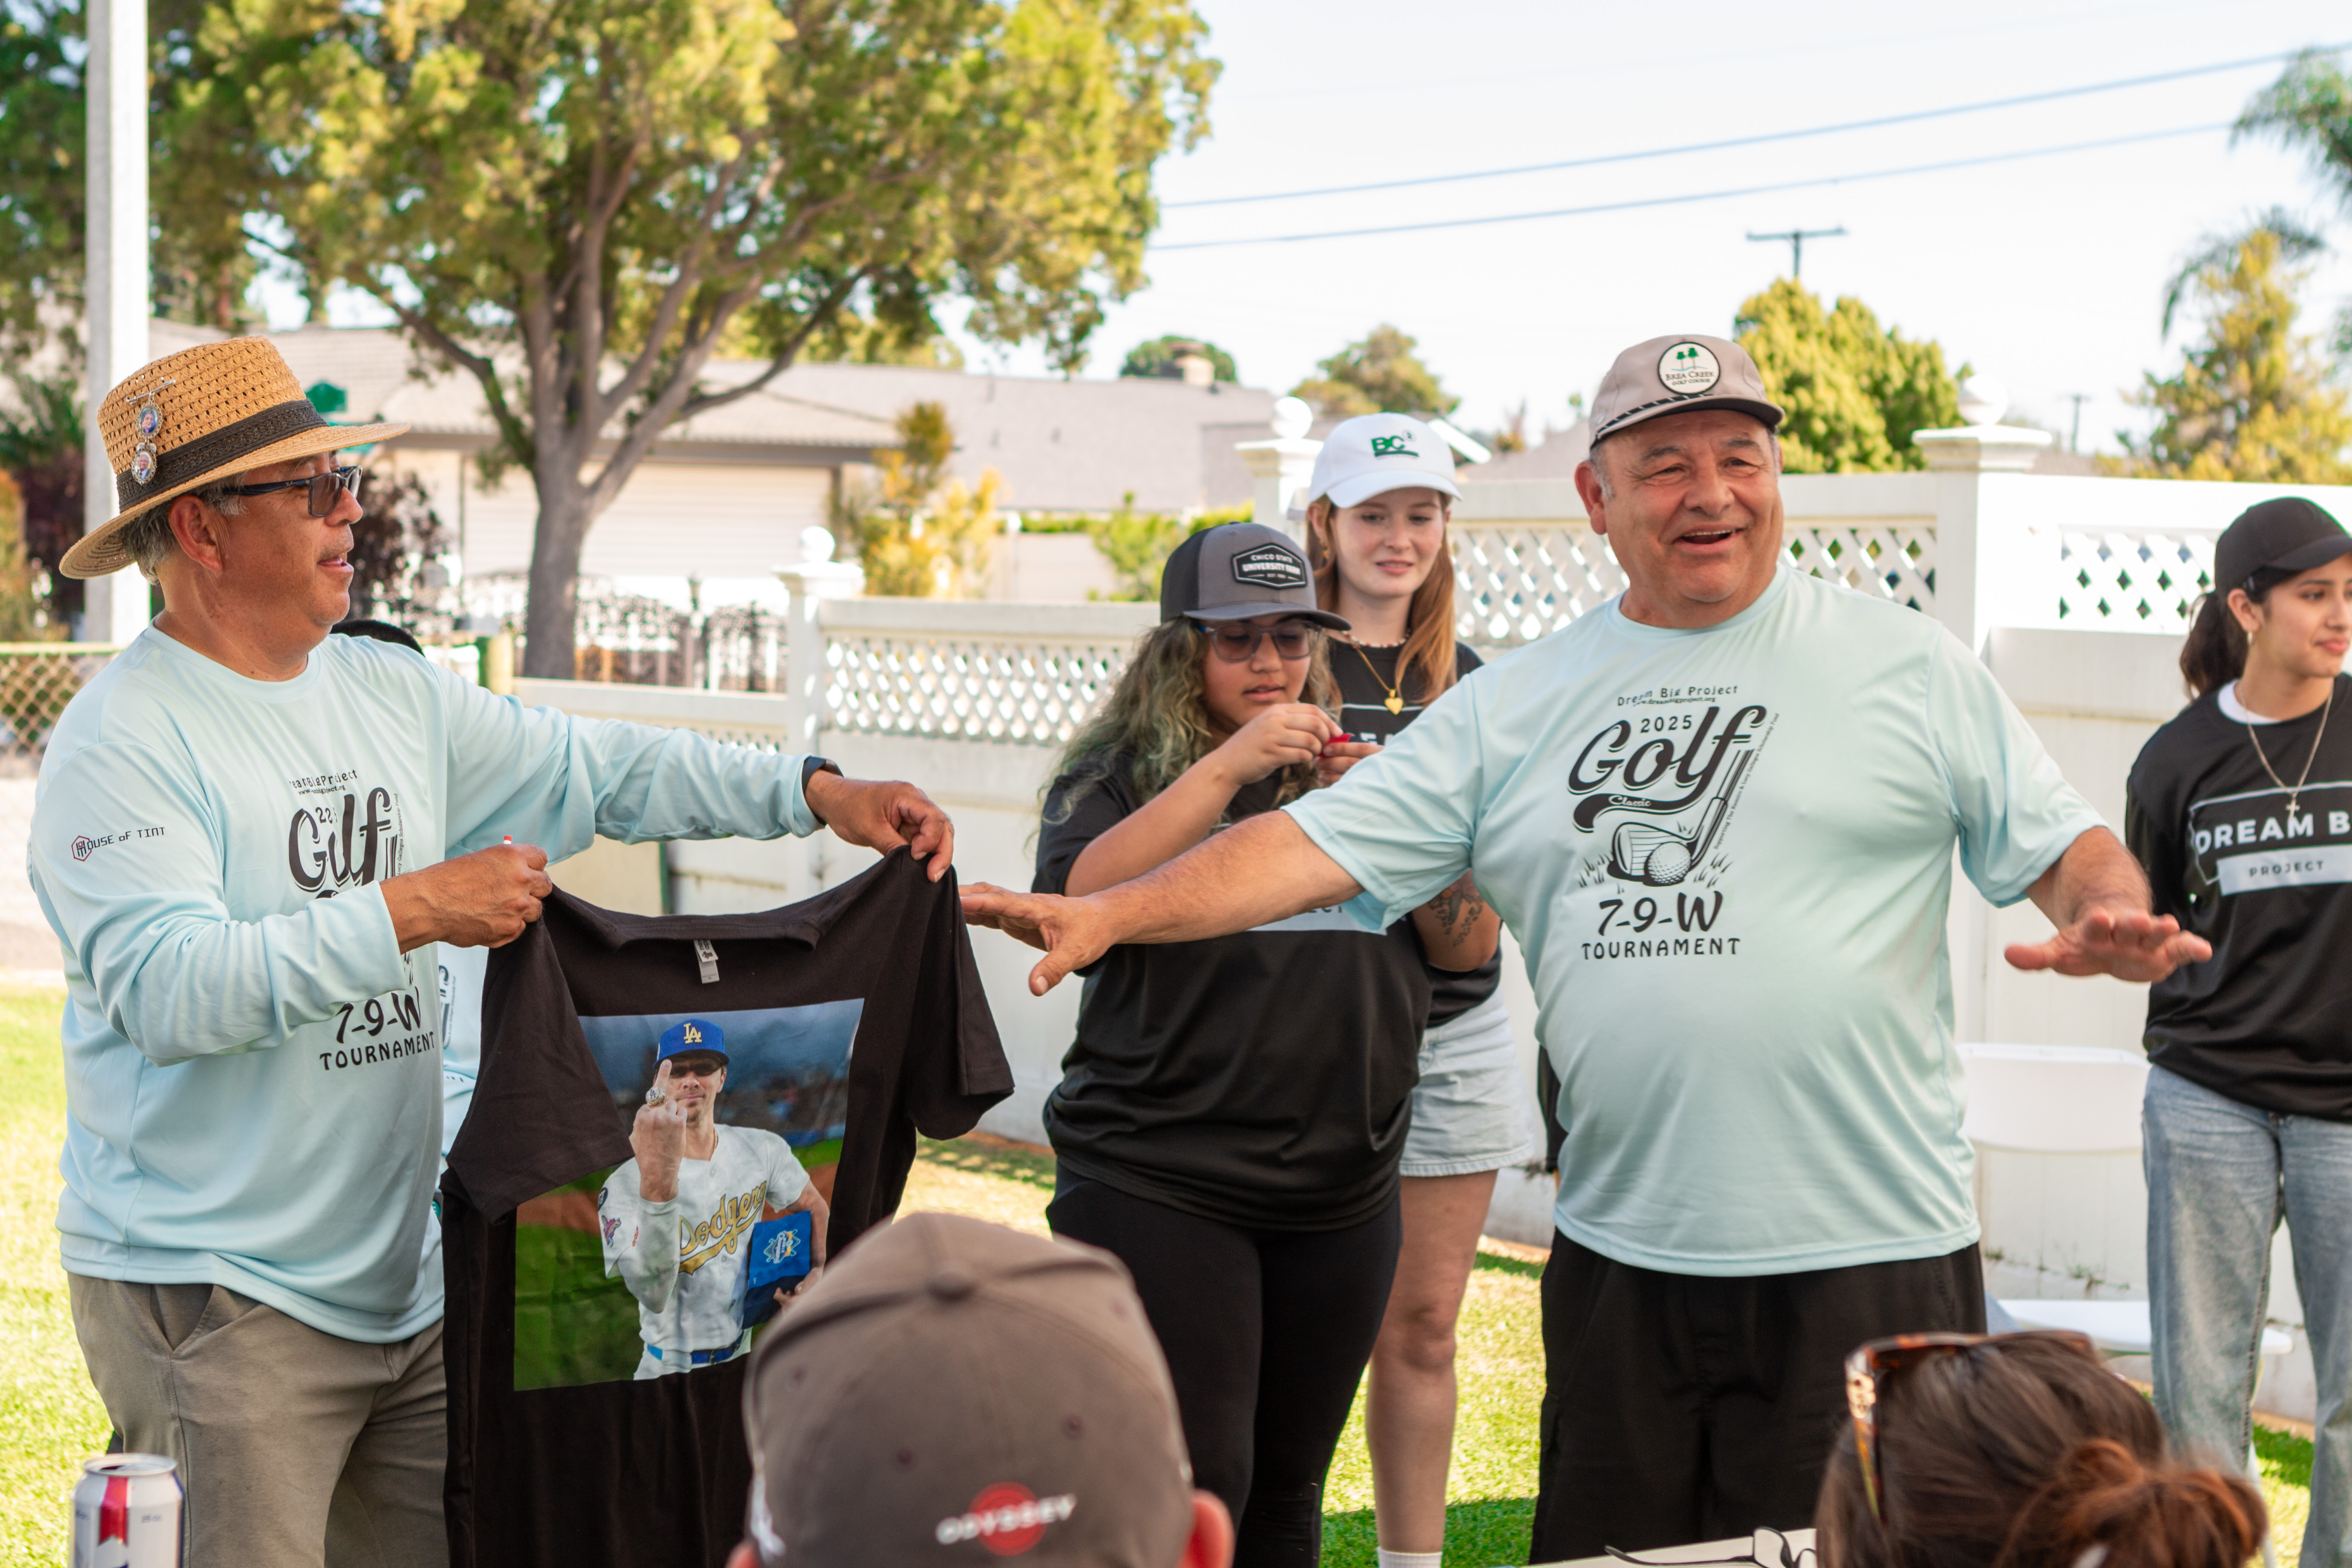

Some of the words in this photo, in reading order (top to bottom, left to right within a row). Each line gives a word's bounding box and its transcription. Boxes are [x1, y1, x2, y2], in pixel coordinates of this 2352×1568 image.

[1688, 686, 1738, 696] Project
[1640, 715, 1692, 733] 2025
[1568, 705, 1767, 833] Golf
[395, 805, 403, 837] Scholarship
[2195, 812, 2314, 855] DREAM
[2249, 861, 2324, 877] PROJECT
[1599, 890, 1723, 937] 7-9-W
[1581, 937, 1740, 960] TOURNAMENT
[335, 986, 421, 1044] 7-9-W
[683, 1023, 703, 1044] LA
[319, 1031, 435, 1071] TOURNAMENT
